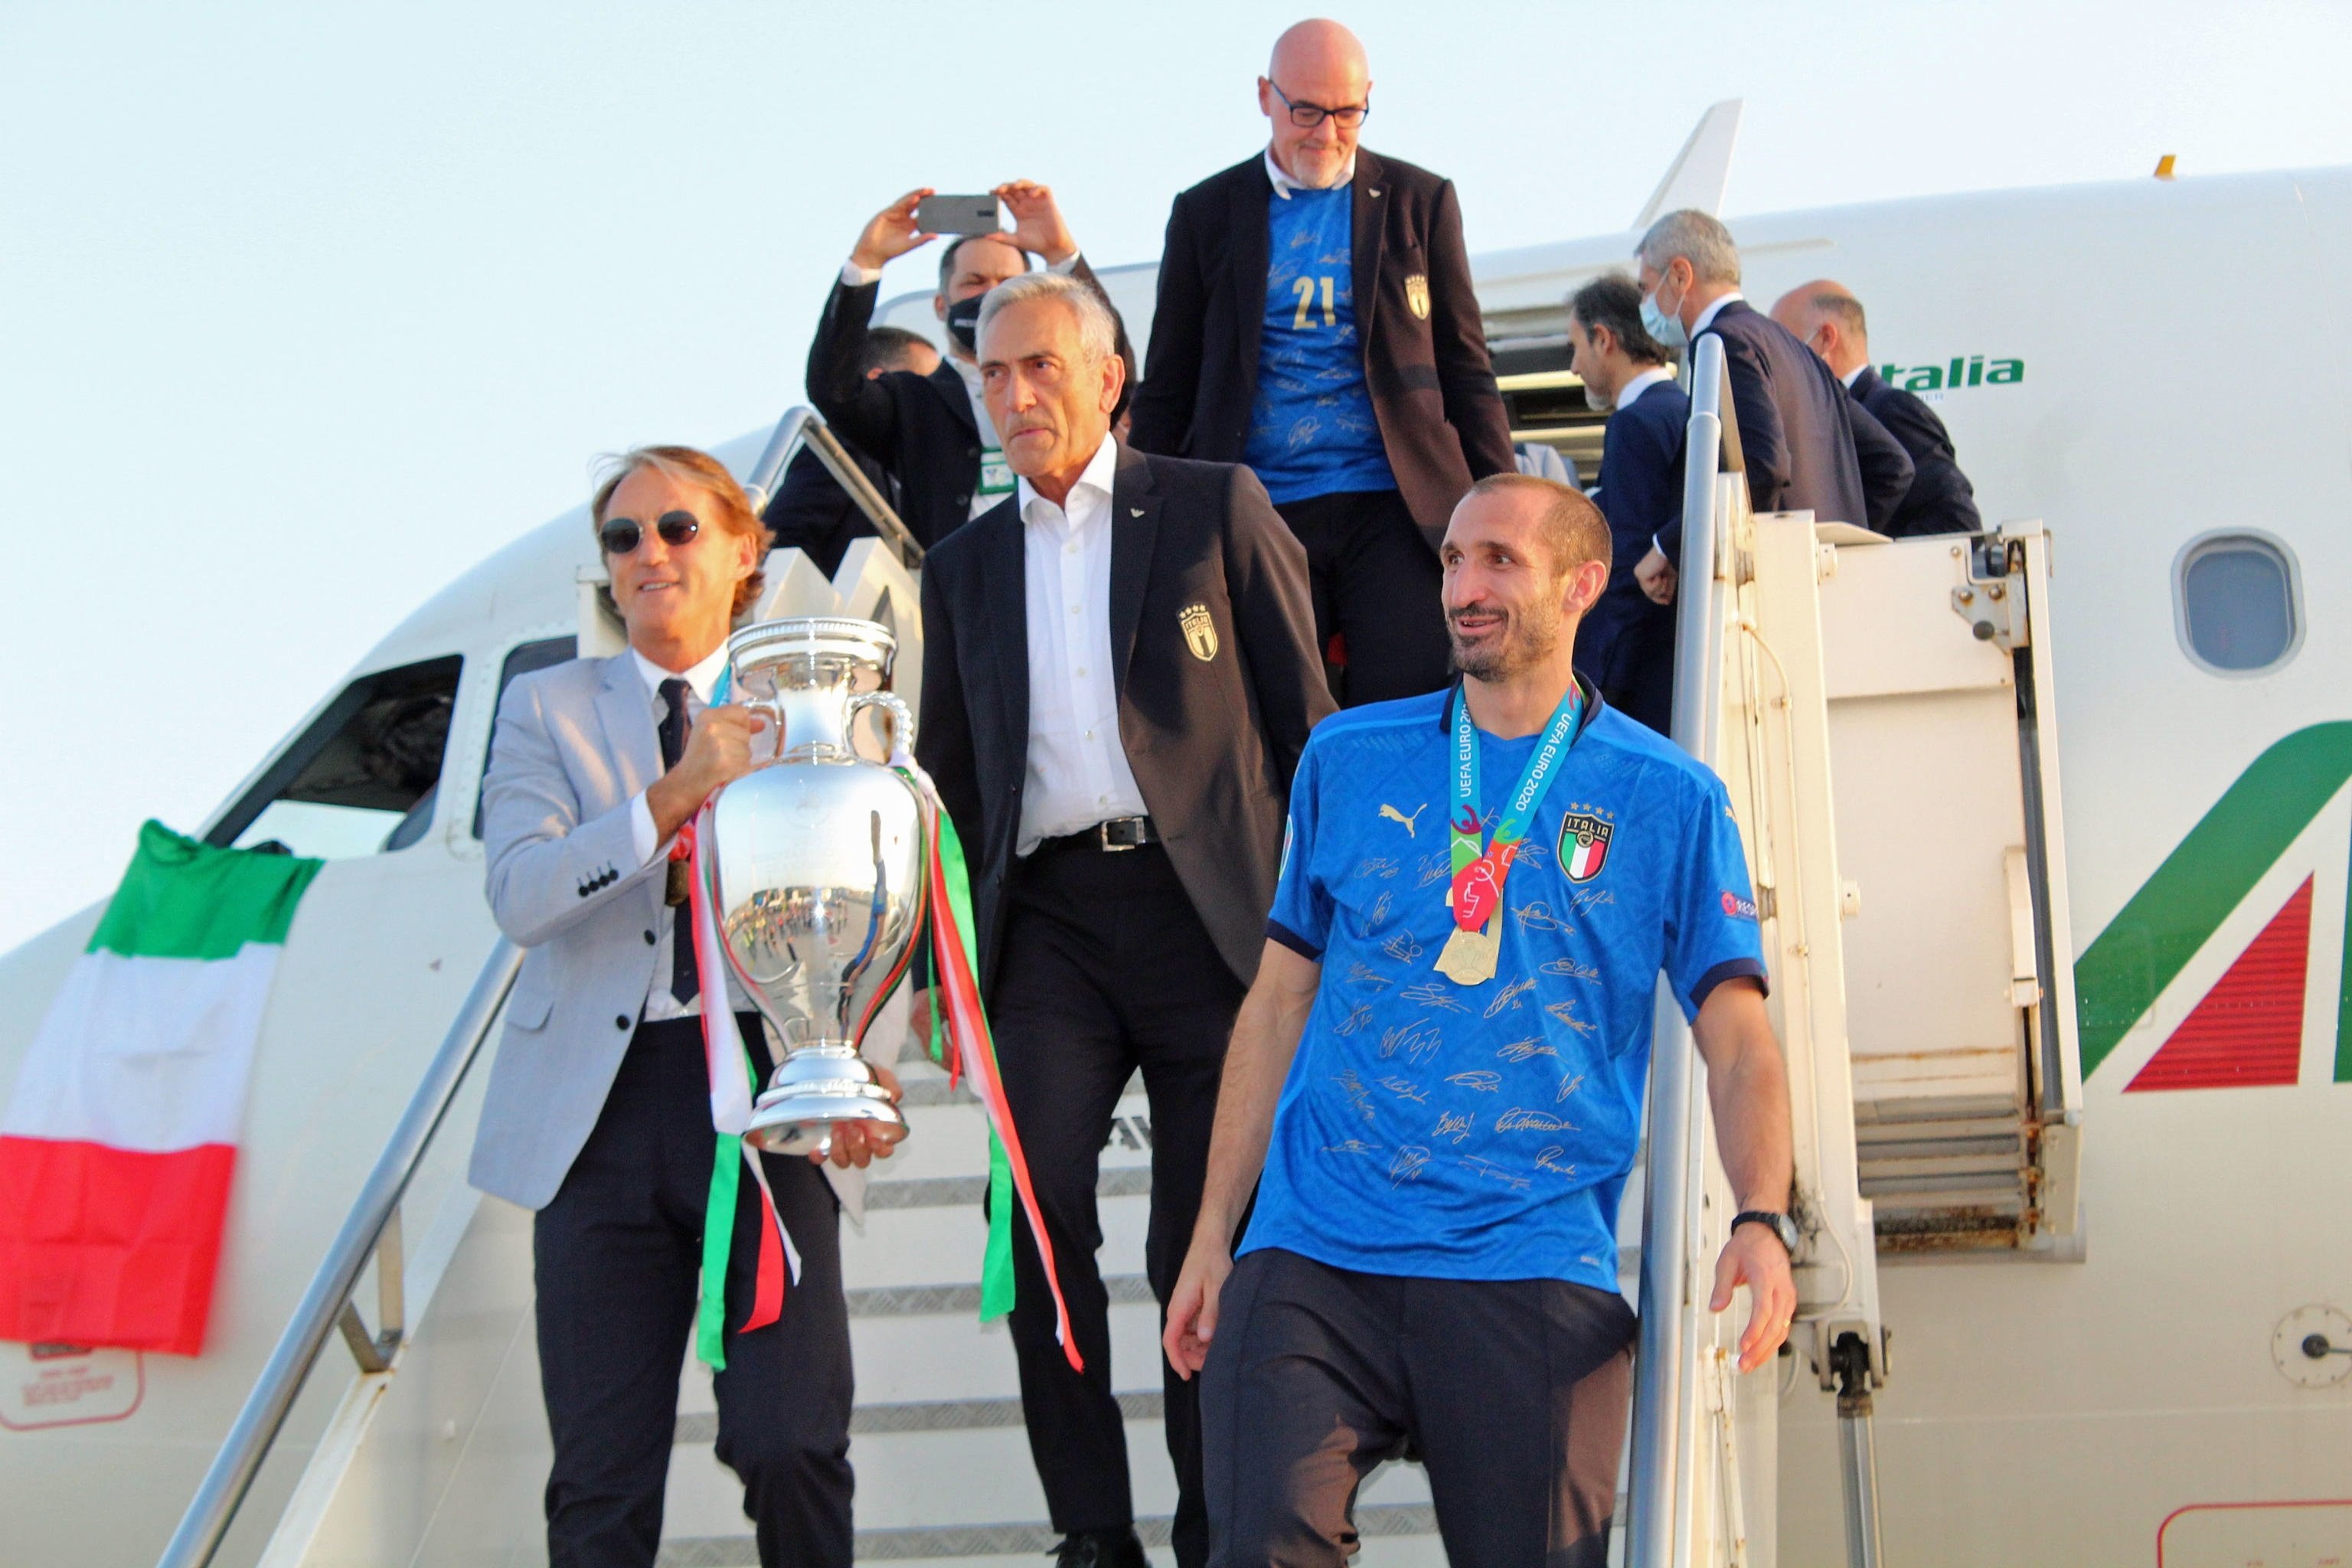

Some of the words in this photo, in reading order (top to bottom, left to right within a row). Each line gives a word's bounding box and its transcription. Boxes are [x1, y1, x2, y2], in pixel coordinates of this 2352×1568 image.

[1292, 276, 1336, 330] 21
[1880, 354, 2025, 392] talia
[1459, 723, 1472, 761] EURO
[1548, 713, 1573, 745] UEFA
[1460, 762, 1472, 798] UEFA
[1531, 744, 1556, 780] EURO
[1515, 778, 1539, 812] 2020
[1567, 818, 1609, 838] ITALIA
